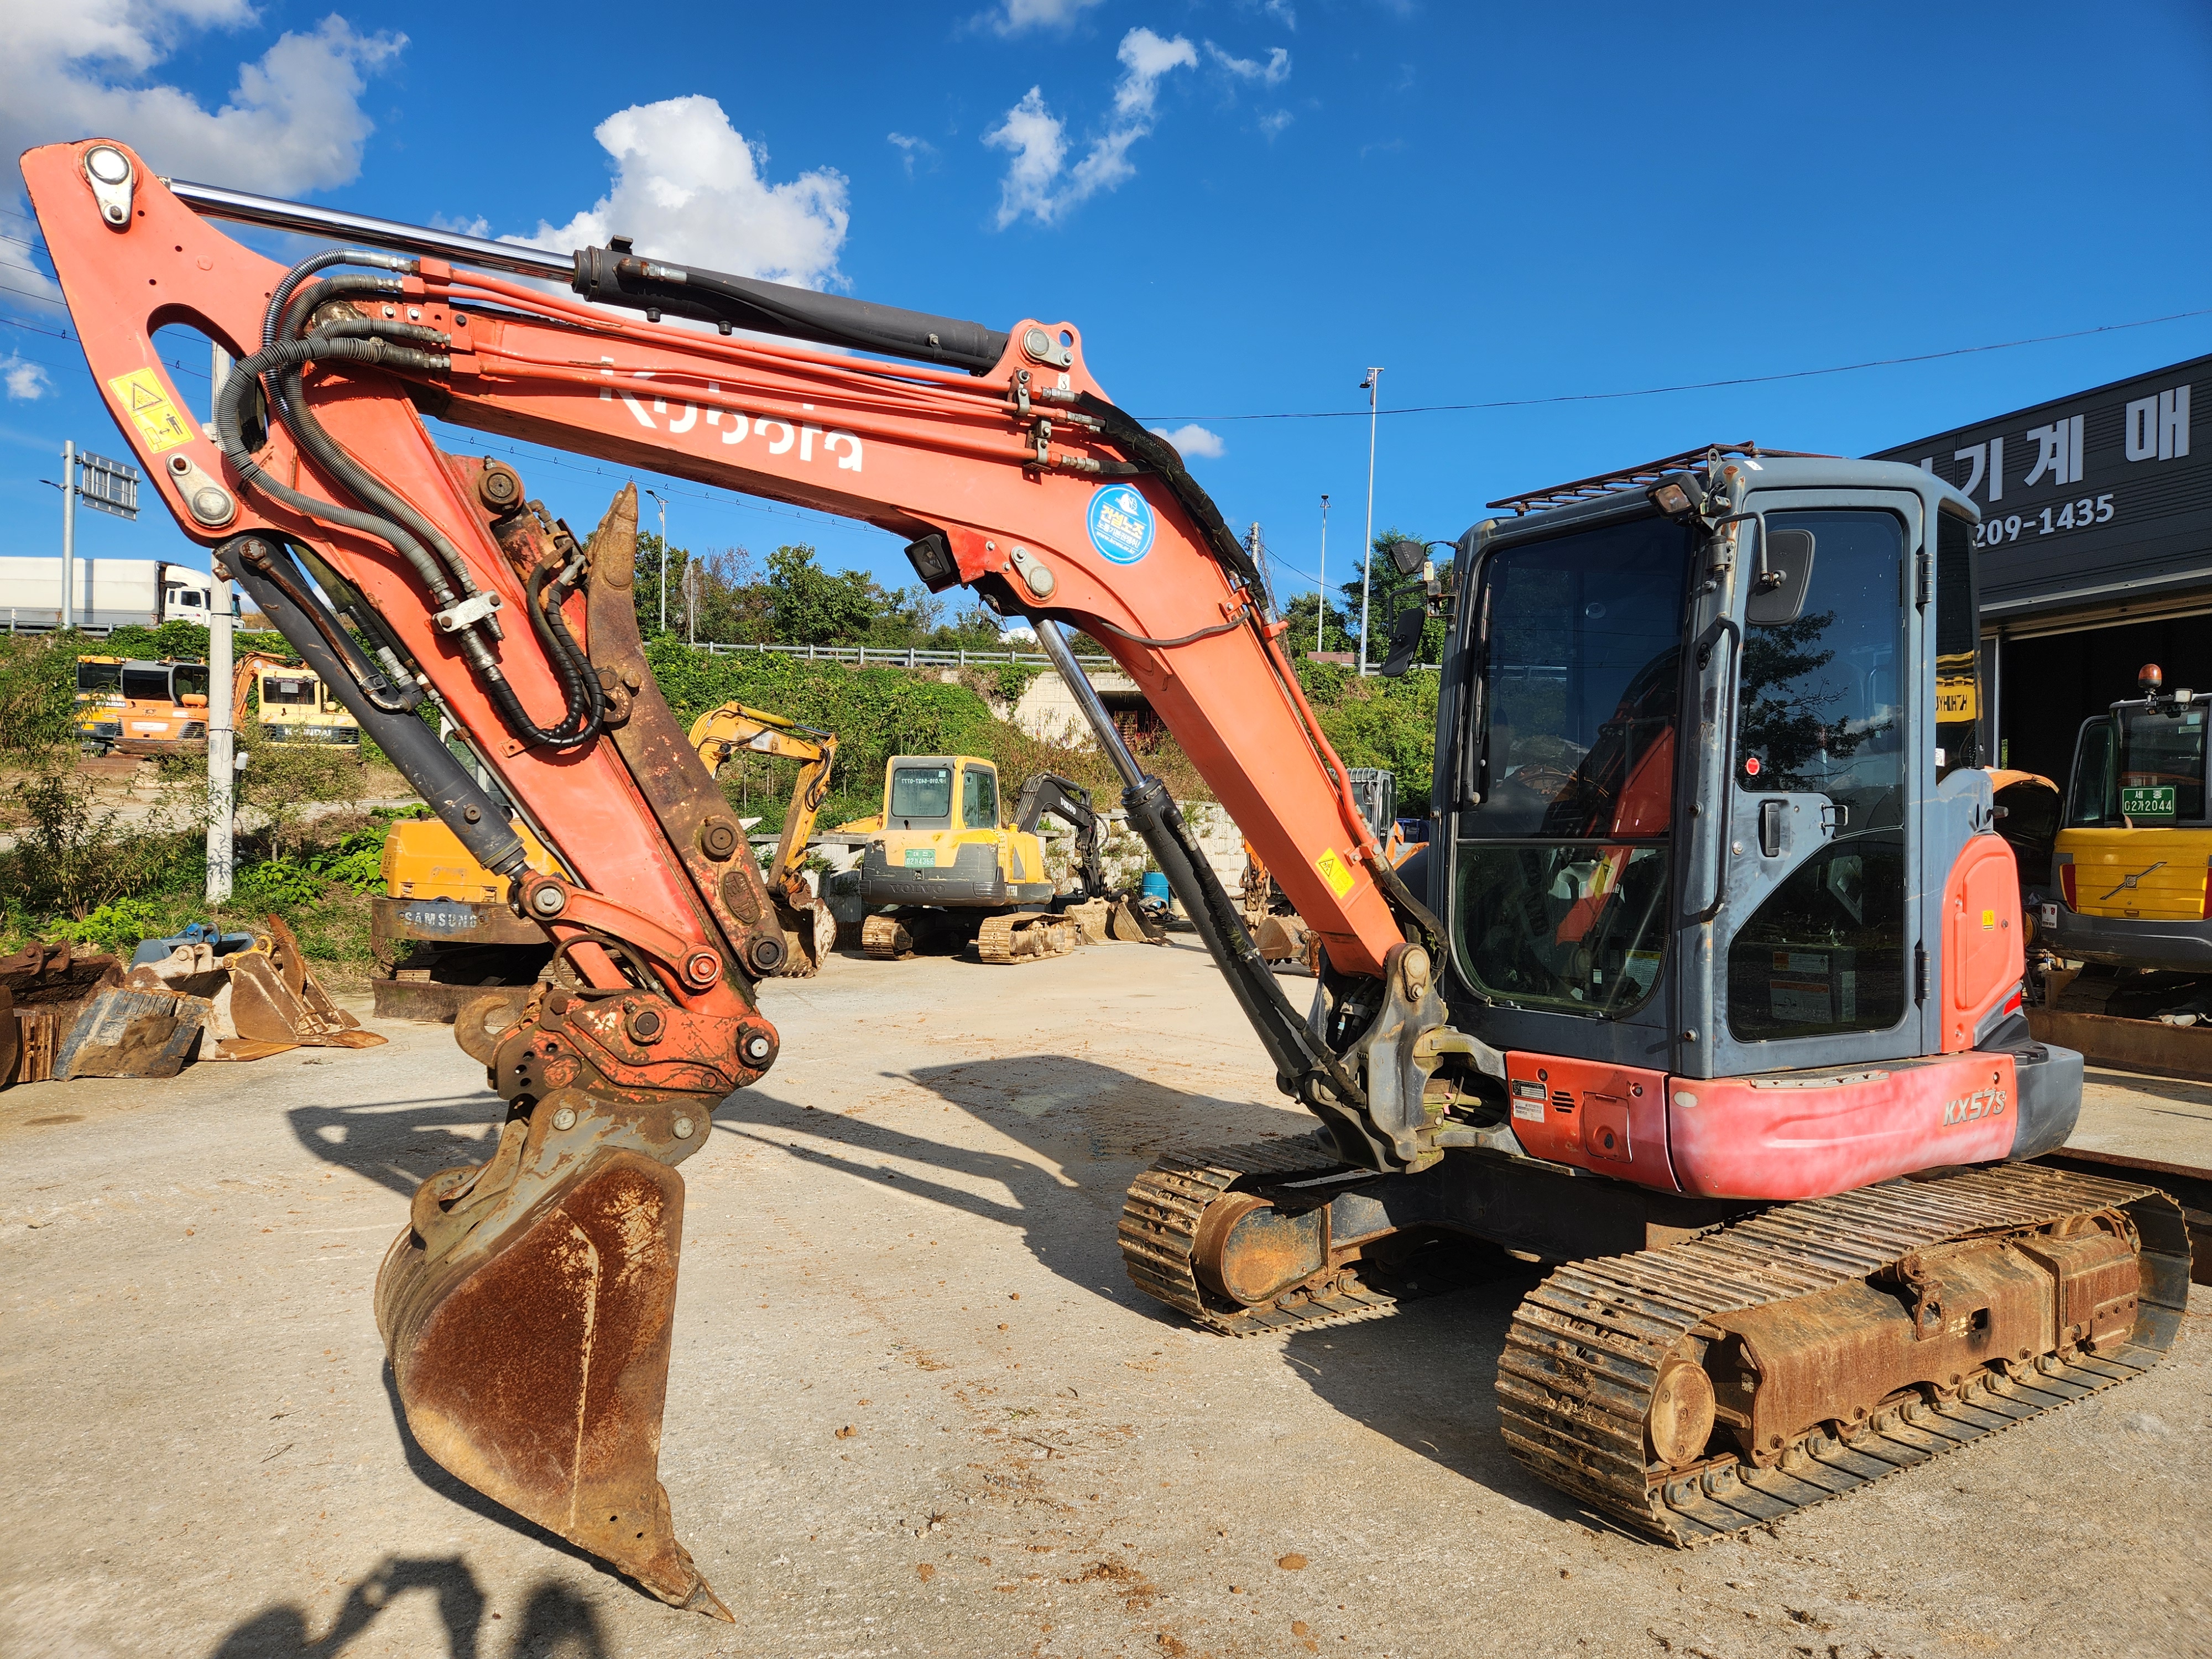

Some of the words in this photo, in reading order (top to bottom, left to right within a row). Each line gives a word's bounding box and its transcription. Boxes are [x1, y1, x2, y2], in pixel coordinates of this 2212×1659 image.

[1920, 414, 2084, 502] 기계
[1100, 504, 1145, 540] 건설노조
[1060, 796, 1076, 815] VOLVO
[2124, 800, 2172, 811] 02가2044
[889, 884, 946, 894] VOLVO
[404, 911, 477, 928] SAMSUNG
